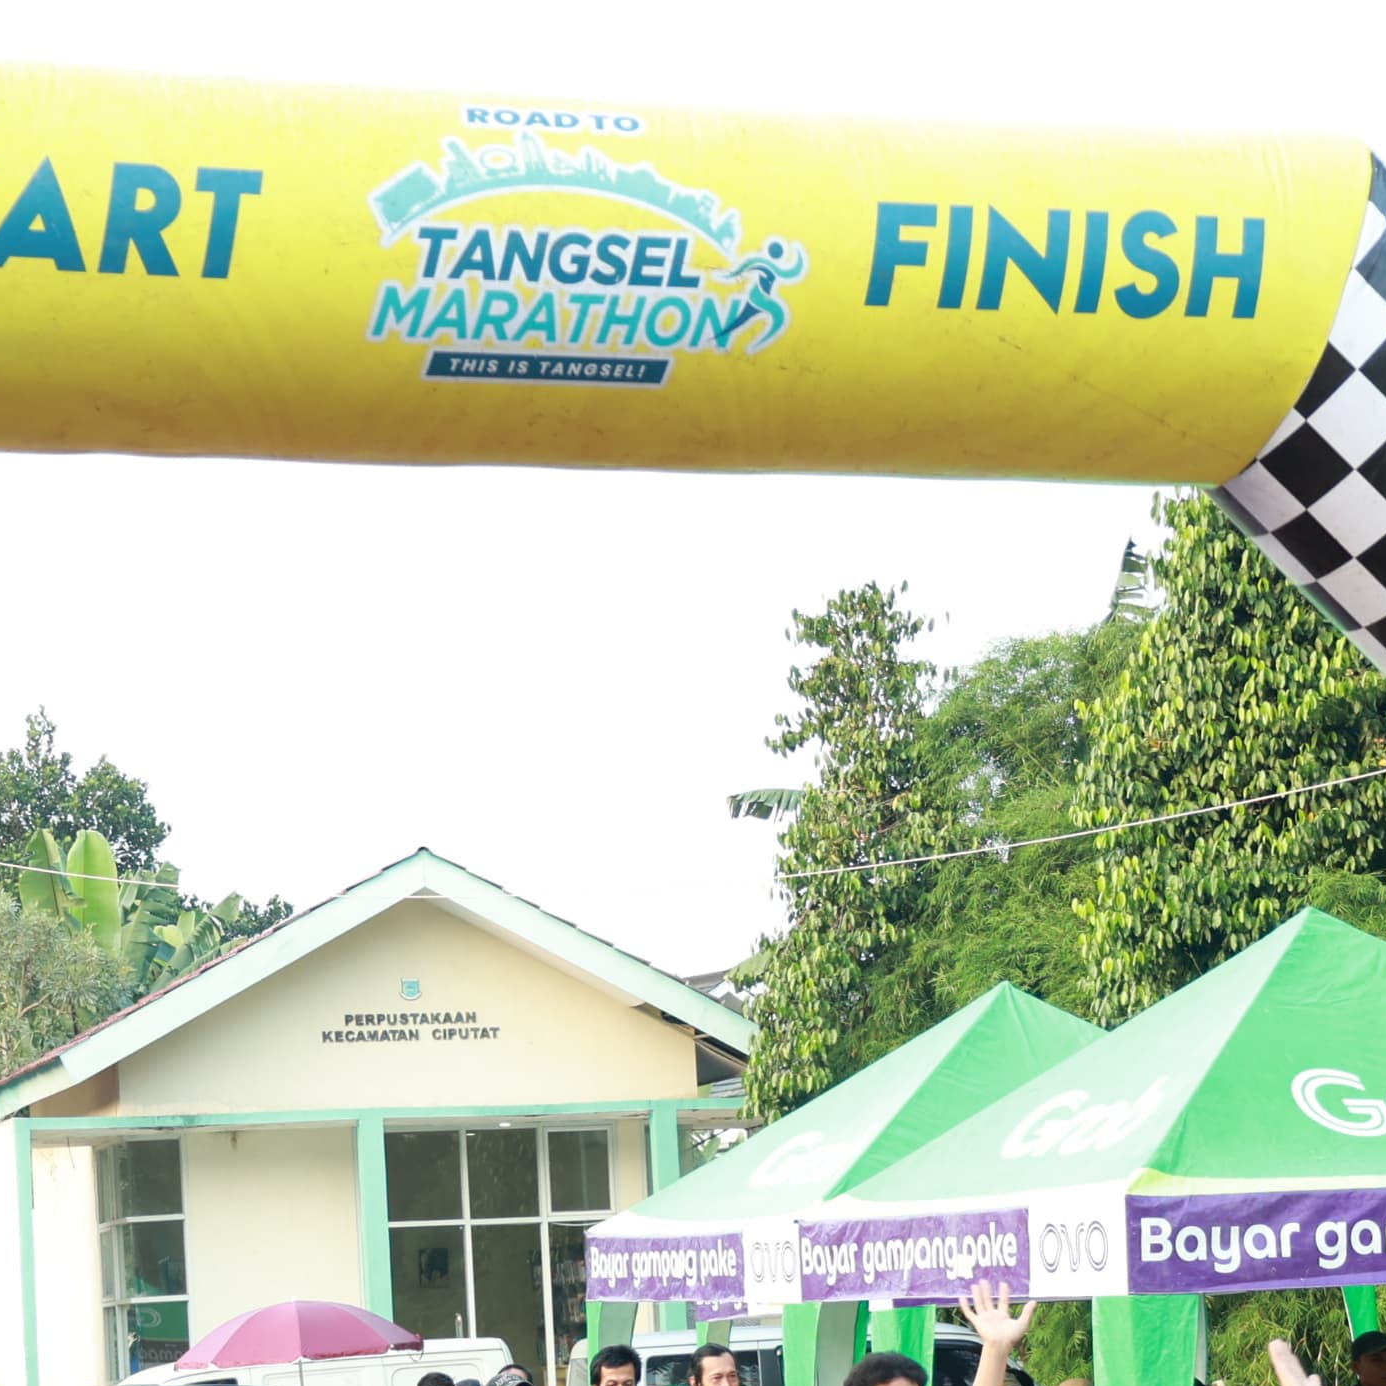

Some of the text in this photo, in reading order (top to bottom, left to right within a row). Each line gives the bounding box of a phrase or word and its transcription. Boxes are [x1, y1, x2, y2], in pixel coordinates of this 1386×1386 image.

[466, 107, 641, 131] ROAD TO
[417, 226, 701, 290] TANGSEL
[861, 200, 1266, 321] FINISH
[370, 286, 751, 350] MARATHON
[448, 357, 646, 380] THIS IS TANGSEL!
[321, 1026, 501, 1044] KECAMATAN CIPUTAT
[344, 1011, 477, 1027] PERPUSTAKAAN
[589, 1246, 630, 1289] Bayar
[699, 1238, 737, 1286] pake
[801, 1237, 858, 1286] Bayar
[862, 1235, 959, 1285] gampang
[1139, 1216, 1301, 1275] Bayar
